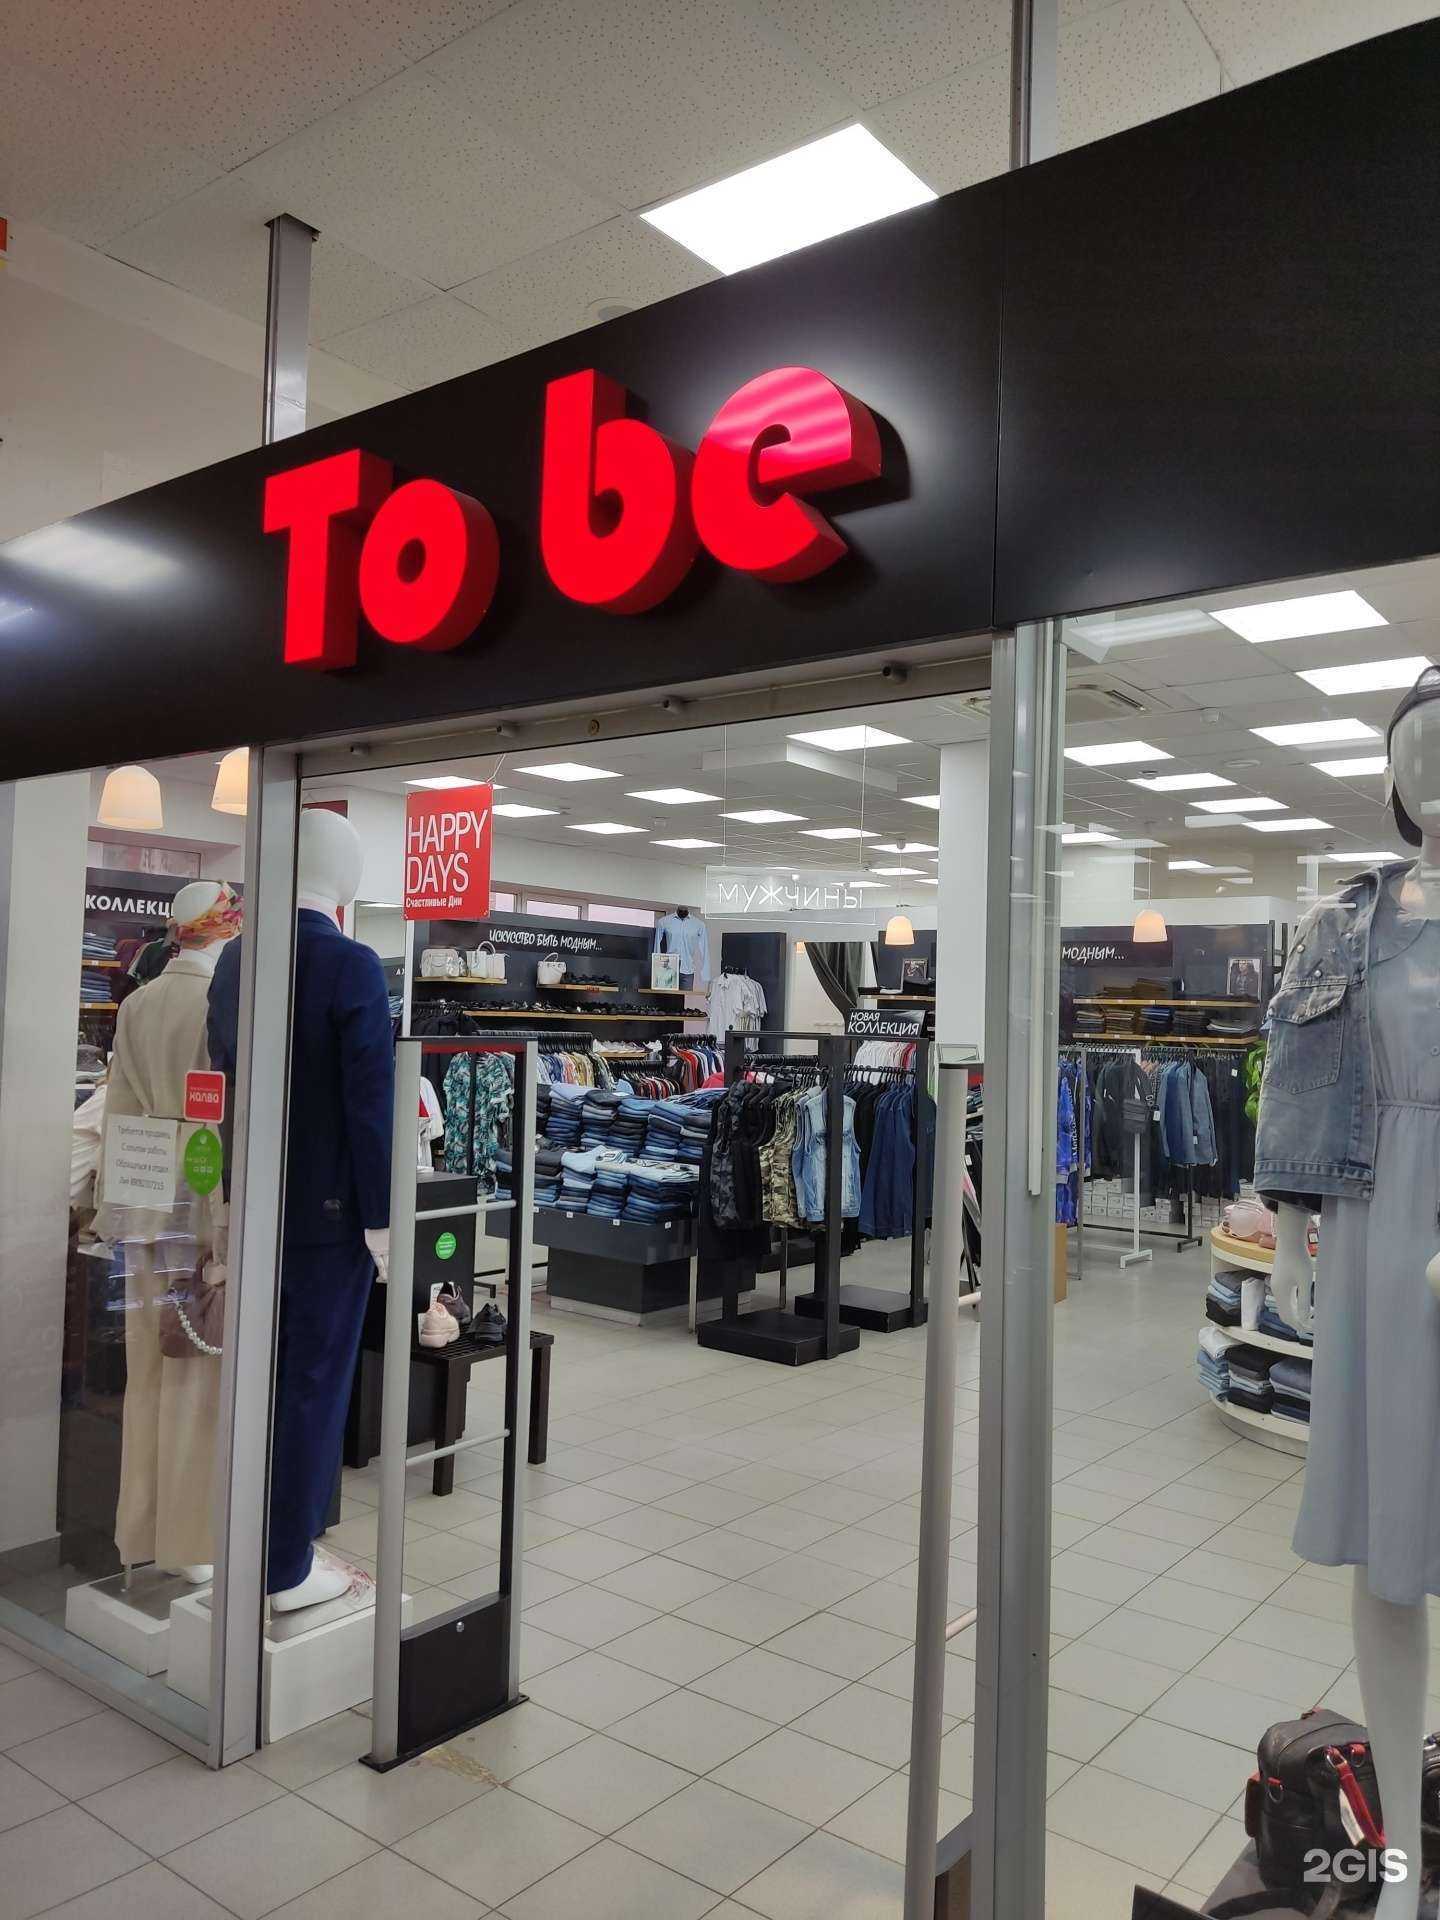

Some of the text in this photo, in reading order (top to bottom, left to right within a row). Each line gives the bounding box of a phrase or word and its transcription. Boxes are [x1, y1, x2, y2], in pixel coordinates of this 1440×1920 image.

[264, 367, 881, 668] To be
[407, 809, 488, 854] HAPPY
[406, 852, 469, 894] DAYS
[536, 933, 559, 947] БЫТЬ
[847, 1021, 920, 1037] КОЛЛЕКЦИЯ
[850, 1012, 880, 1021] НОВАЯ
